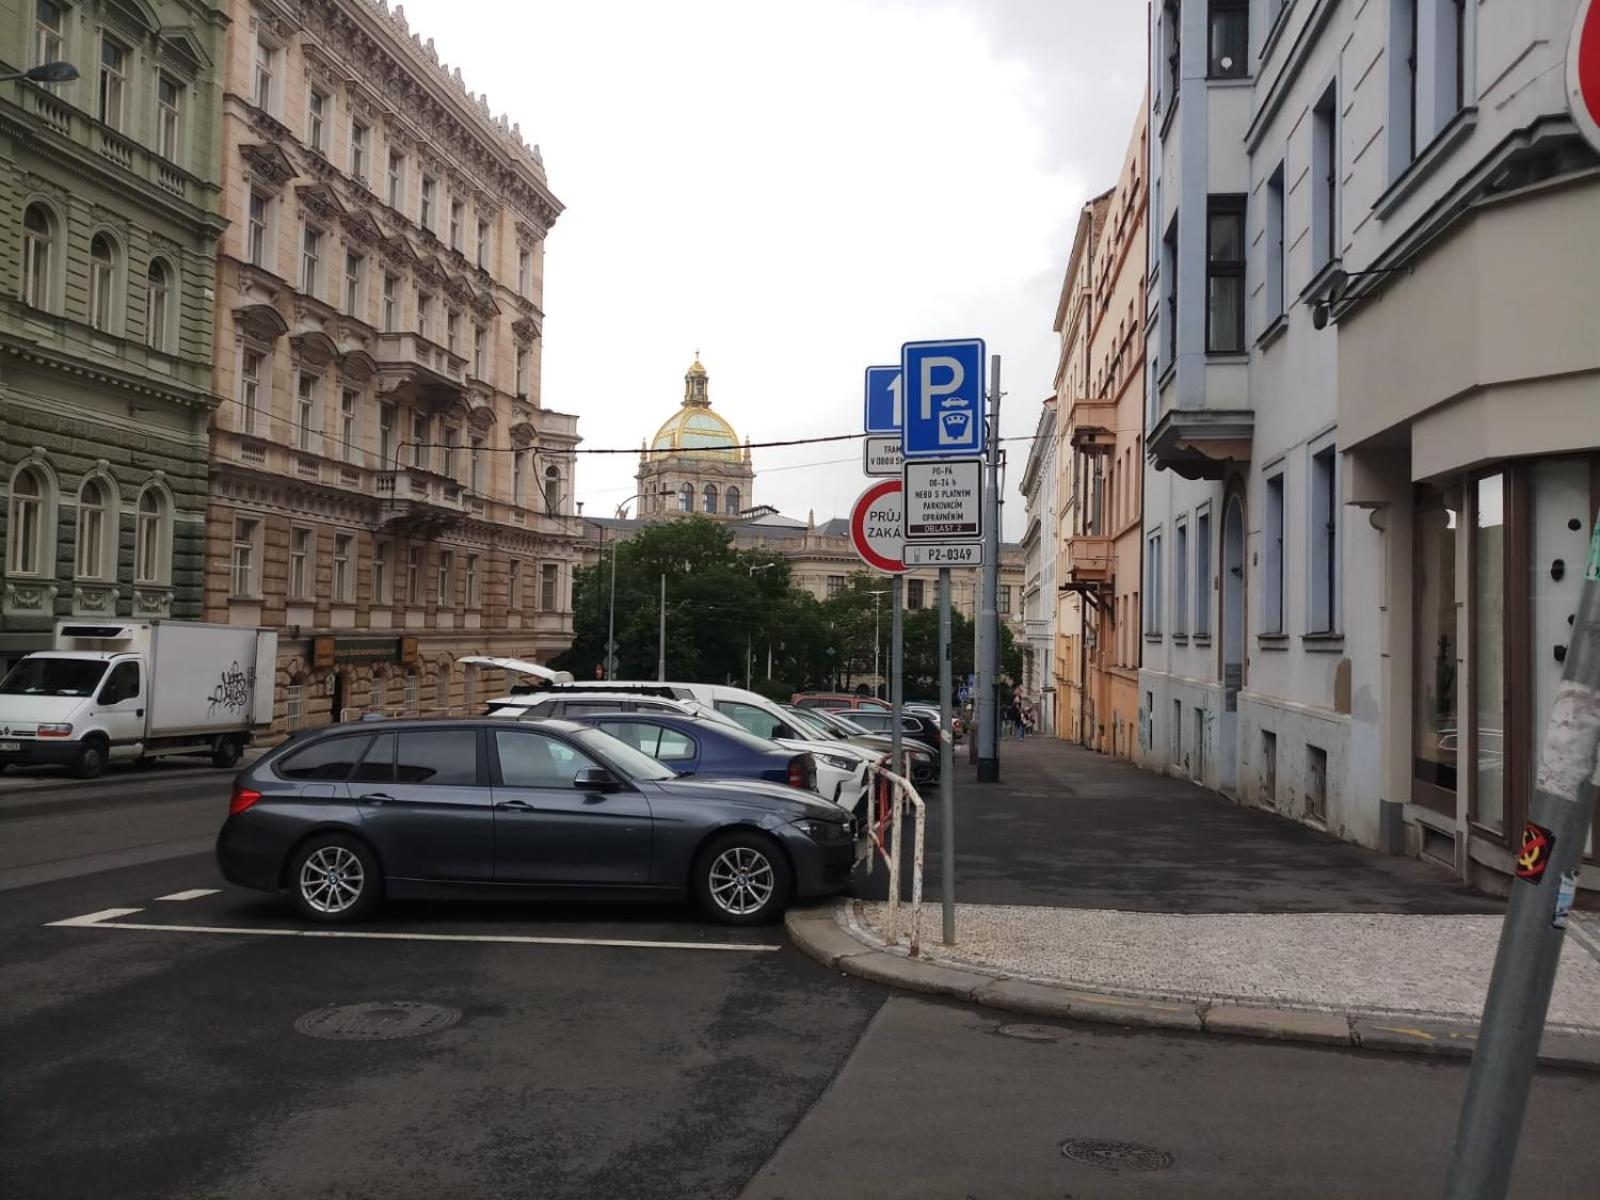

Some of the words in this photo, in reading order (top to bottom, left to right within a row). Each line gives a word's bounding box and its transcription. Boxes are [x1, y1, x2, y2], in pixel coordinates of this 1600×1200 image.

[920, 356, 965, 420] P
[871, 457, 875, 465] V
[915, 489, 932, 499] NEBO
[934, 489, 939, 498] S
[941, 487, 971, 498] PLATNÝM
[923, 500, 963, 510] PARKOVACÍM
[922, 511, 964, 522] OPRÁVNĚNÍM
[924, 524, 954, 533] OBLAST
[956, 524, 962, 532] 2
[928, 548, 972, 561] P2-0349
